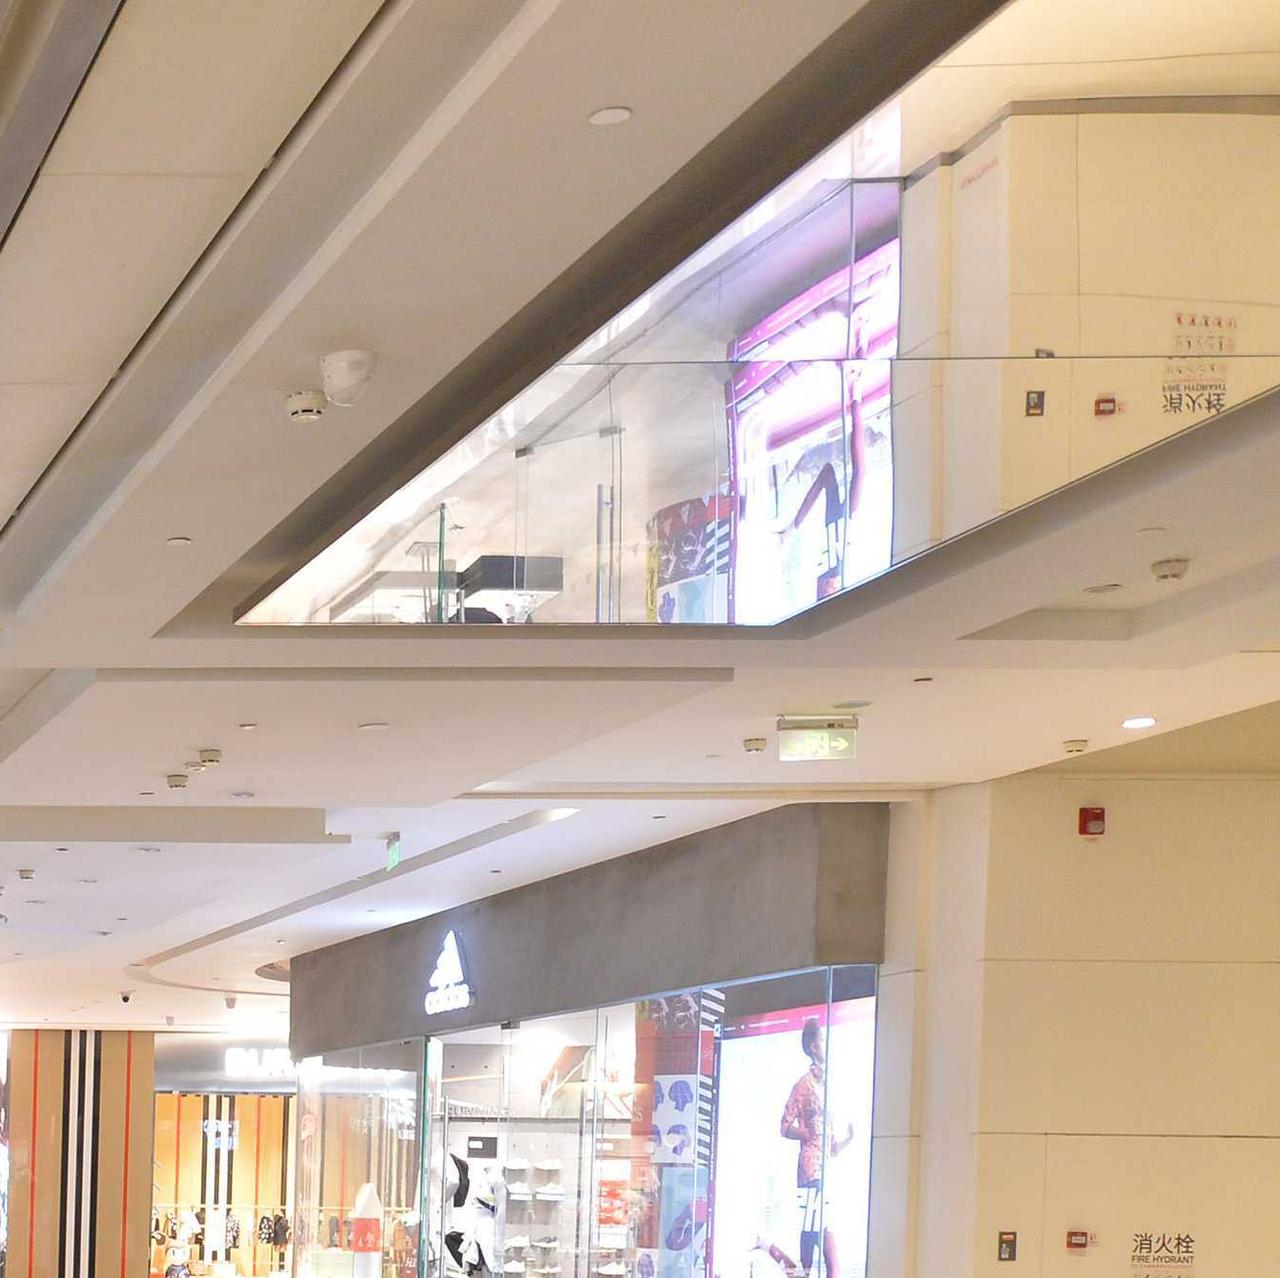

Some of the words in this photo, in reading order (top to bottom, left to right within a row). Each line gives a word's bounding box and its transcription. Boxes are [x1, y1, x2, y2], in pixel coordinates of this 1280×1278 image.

[1132, 1233, 1194, 1254] 消火栓
[1131, 1254, 1150, 1264] FIRE
[1152, 1255, 1194, 1265] HYDRANT
